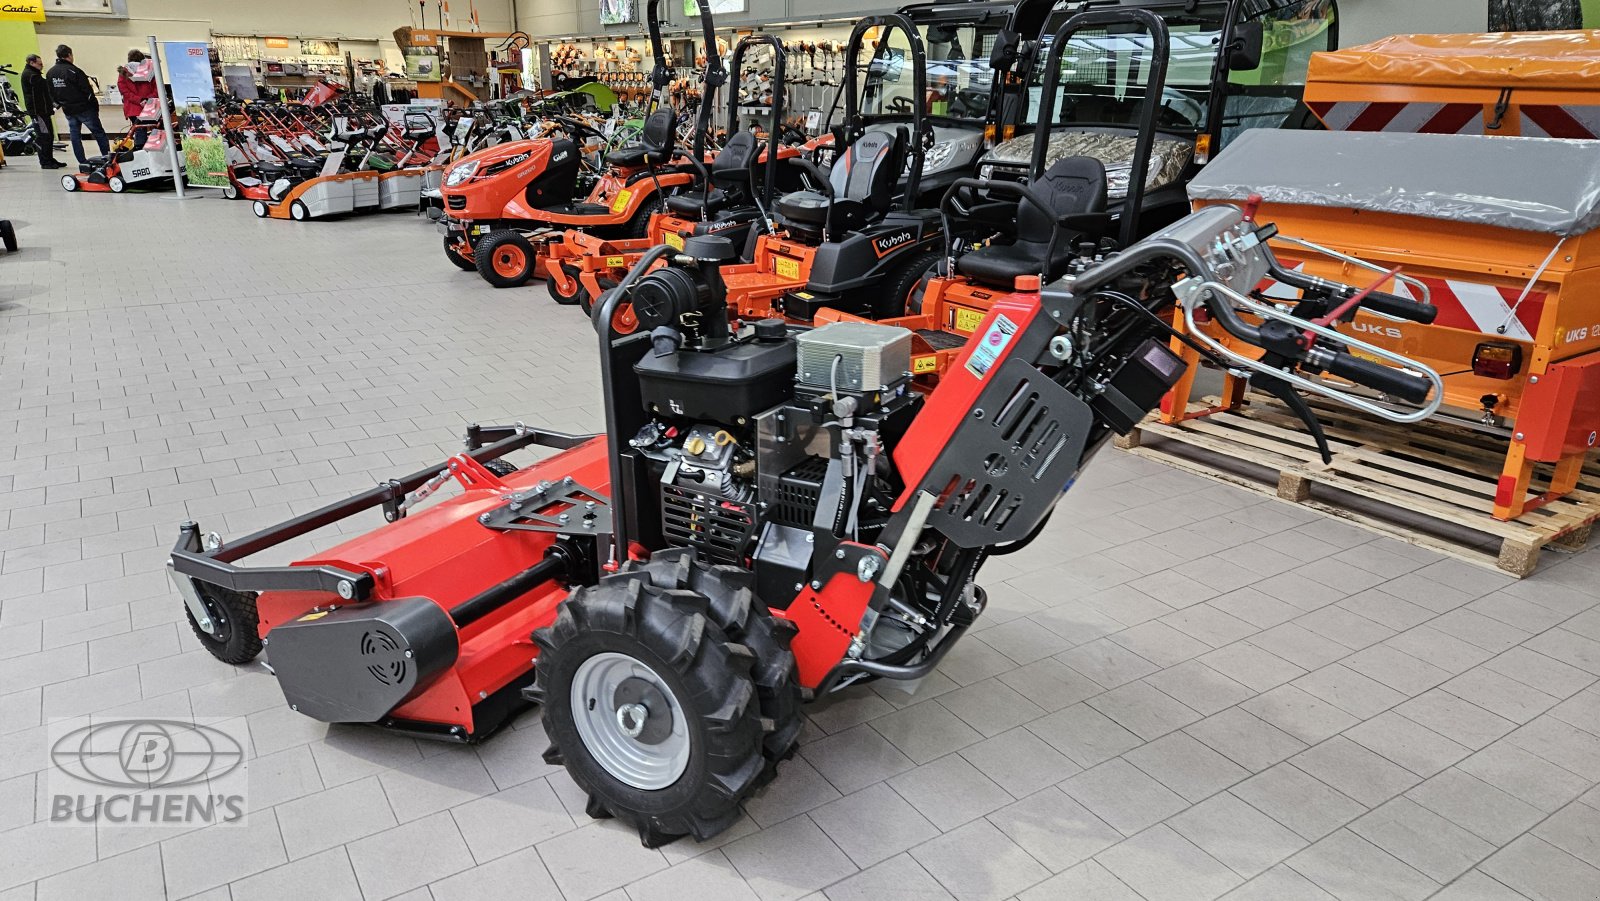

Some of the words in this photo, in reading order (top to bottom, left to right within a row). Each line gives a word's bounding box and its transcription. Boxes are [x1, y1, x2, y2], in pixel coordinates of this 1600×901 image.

[2, 5, 38, 13] Cadet
[505, 153, 530, 166] Kubota
[132, 167, 151, 178] SABO
[713, 220, 737, 230] Kubota
[879, 232, 911, 249] Kubota
[1351, 321, 1402, 339] UKS
[1565, 327, 1588, 343] UKS
